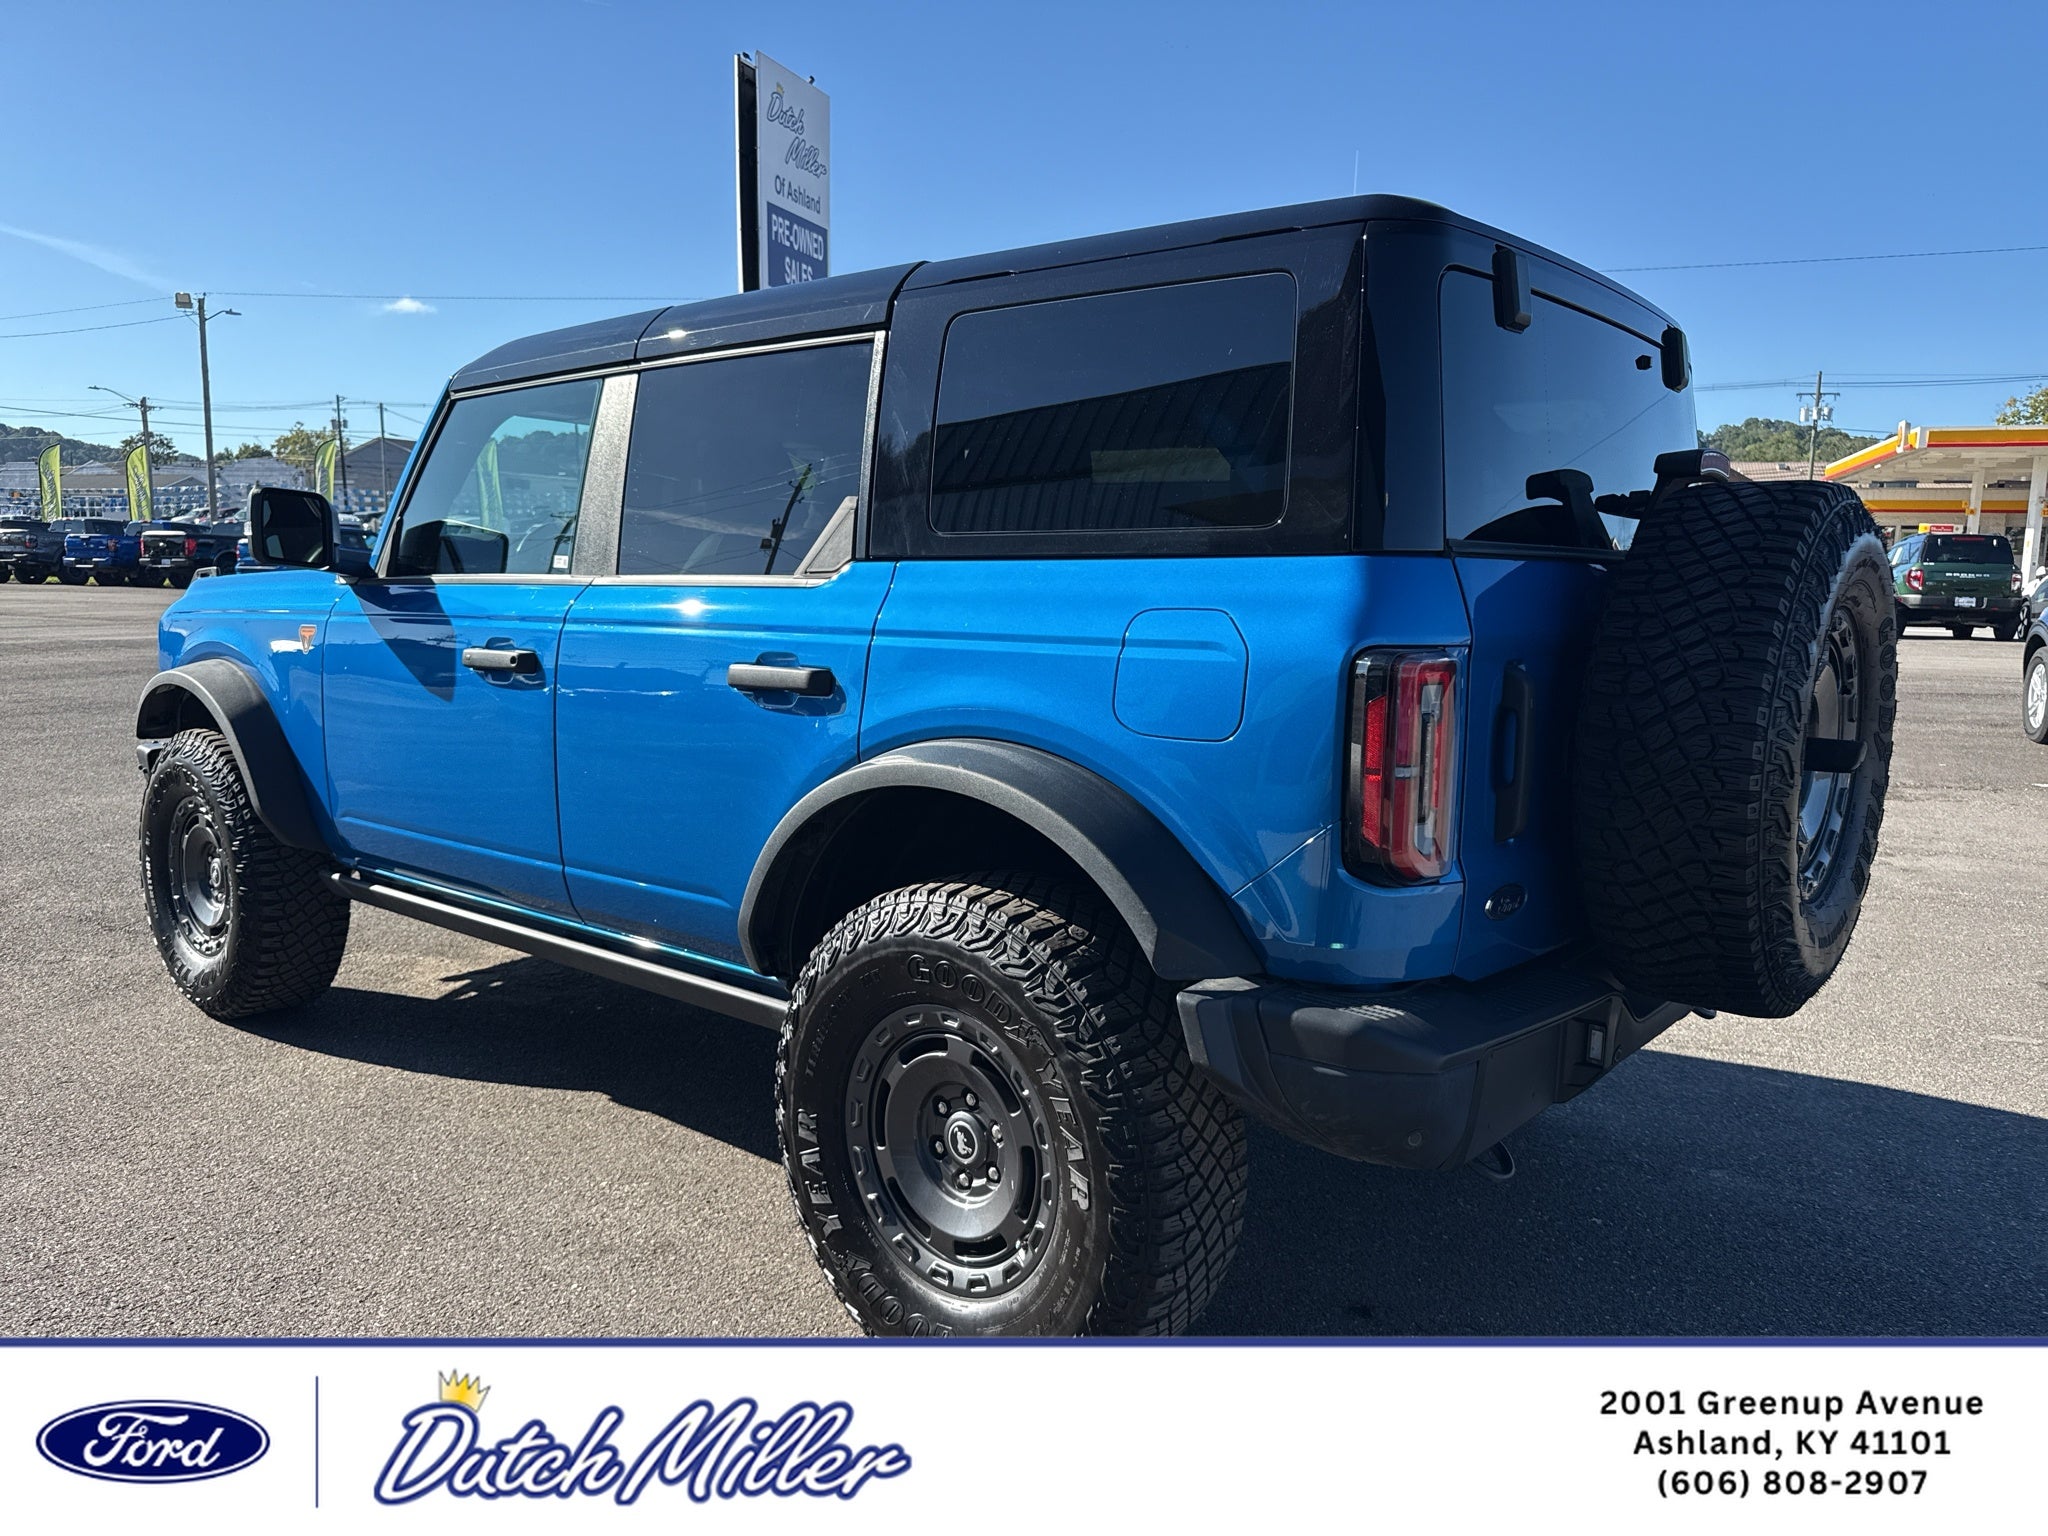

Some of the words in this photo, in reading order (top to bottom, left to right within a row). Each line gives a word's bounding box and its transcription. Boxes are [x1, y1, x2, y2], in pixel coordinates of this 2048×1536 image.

[766, 91, 805, 136] Dutch
[785, 136, 827, 179] Miller
[775, 175, 786, 196] Of
[787, 180, 821, 214] Ashland
[772, 213, 825, 261] PRE-OWNED
[784, 256, 814, 284] SALES
[906, 953, 1092, 1212] GOODYEAR
